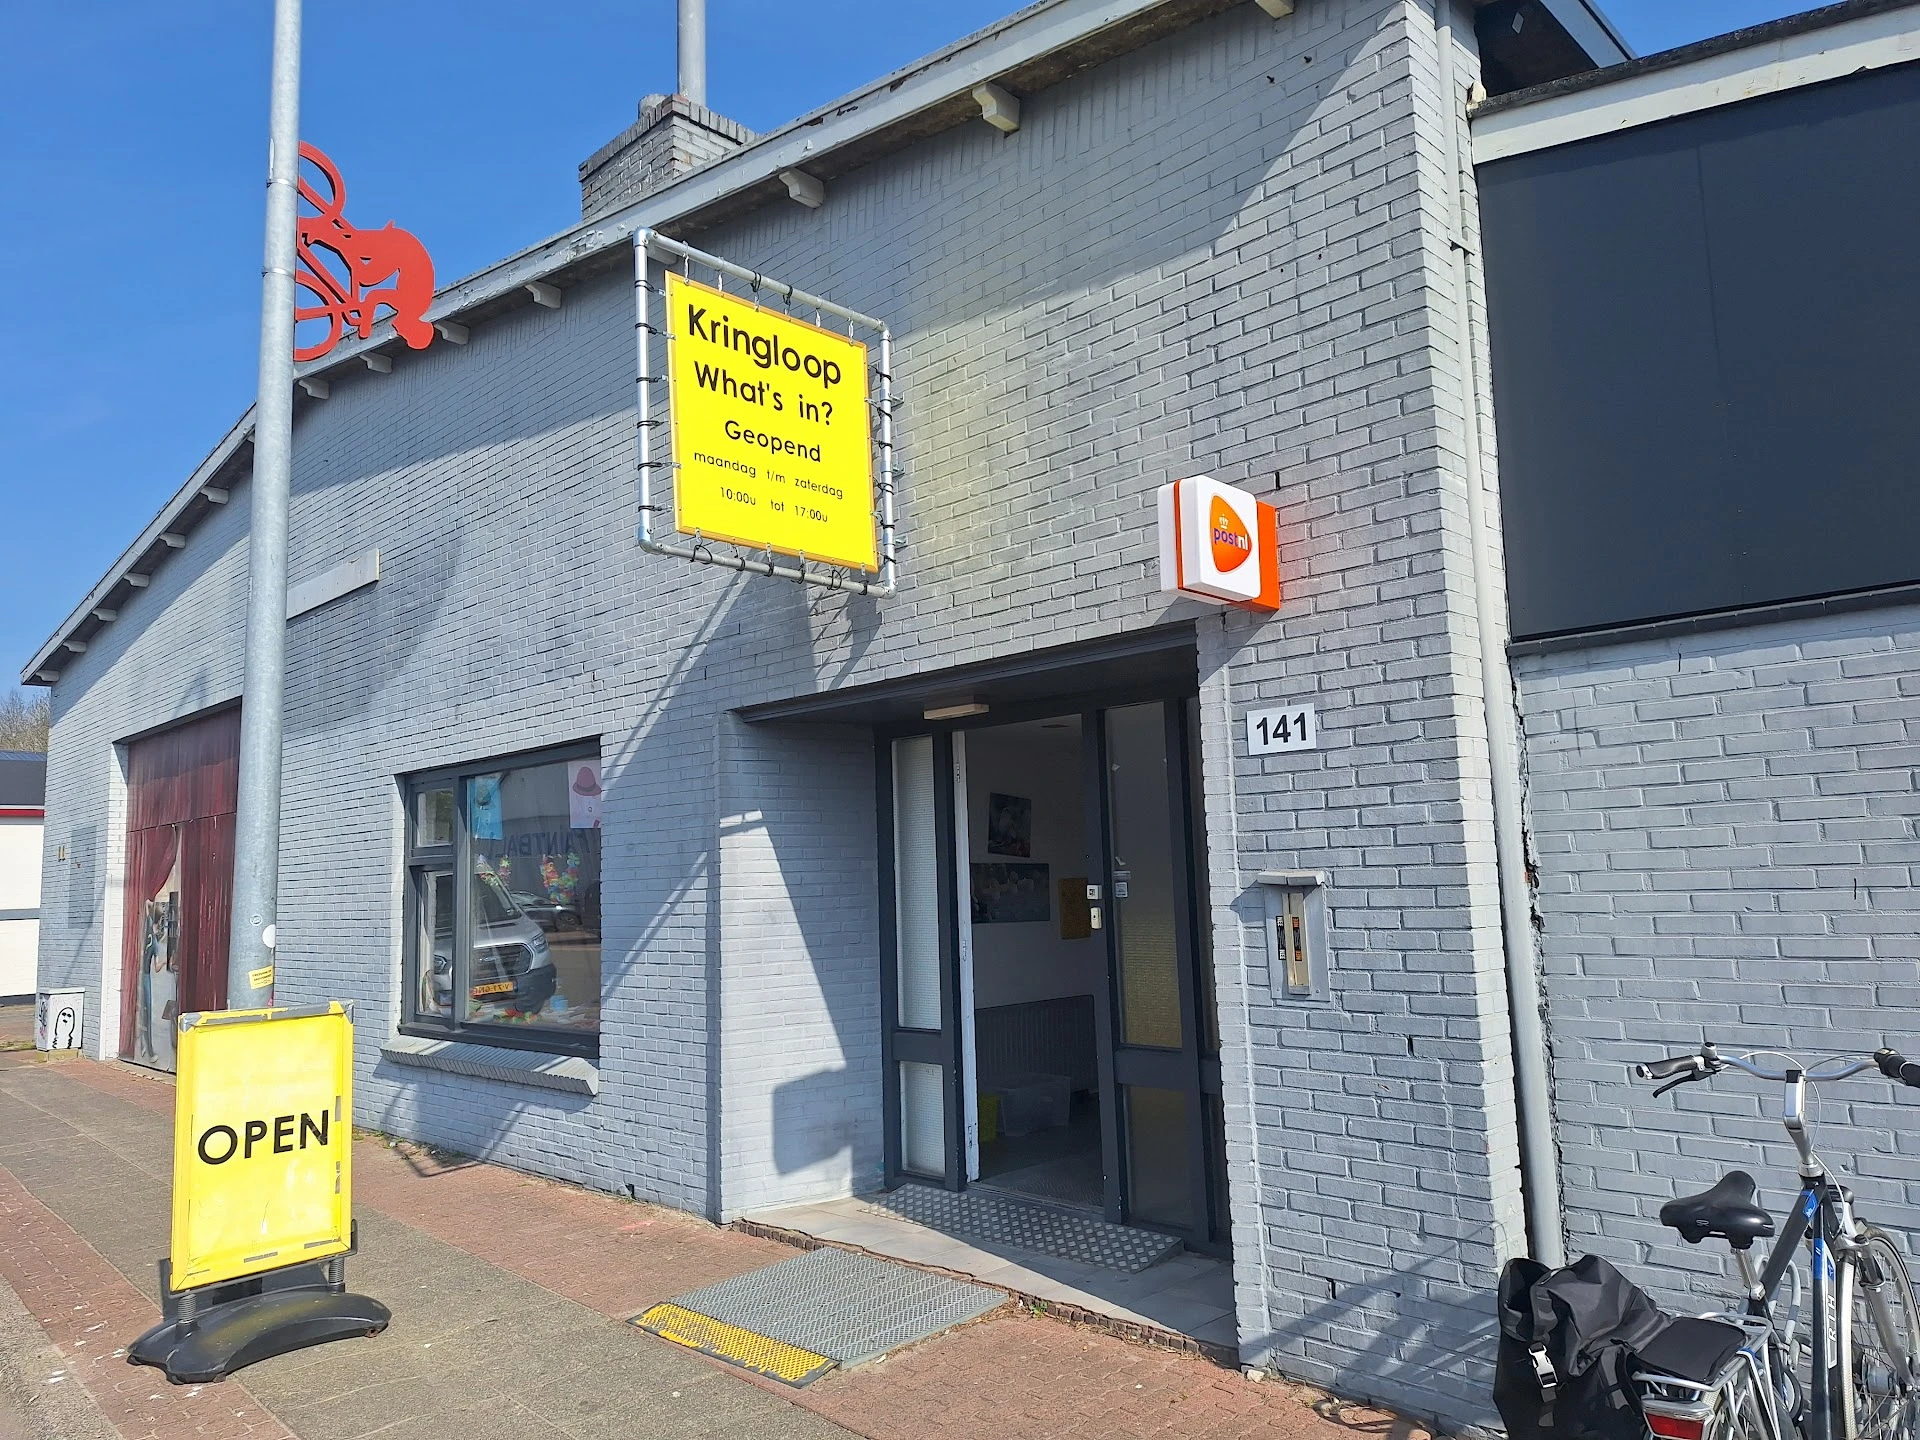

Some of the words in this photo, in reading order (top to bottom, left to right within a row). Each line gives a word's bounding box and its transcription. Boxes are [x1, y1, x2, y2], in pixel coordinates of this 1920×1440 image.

[688, 303, 841, 389] Kringloop
[694, 360, 784, 411] What's
[798, 393, 833, 425] in?
[724, 419, 821, 462] Geopend
[694, 451, 756, 478] maandag
[766, 469, 786, 483] t/m
[794, 477, 843, 500] zaterdag
[720, 486, 756, 505] 10:00u
[770, 498, 785, 512] tot
[794, 504, 828, 523] 17:00u
[1256, 711, 1307, 746] 141
[197, 1109, 330, 1166] OPEN
[1827, 1293, 1837, 1342] RIH
